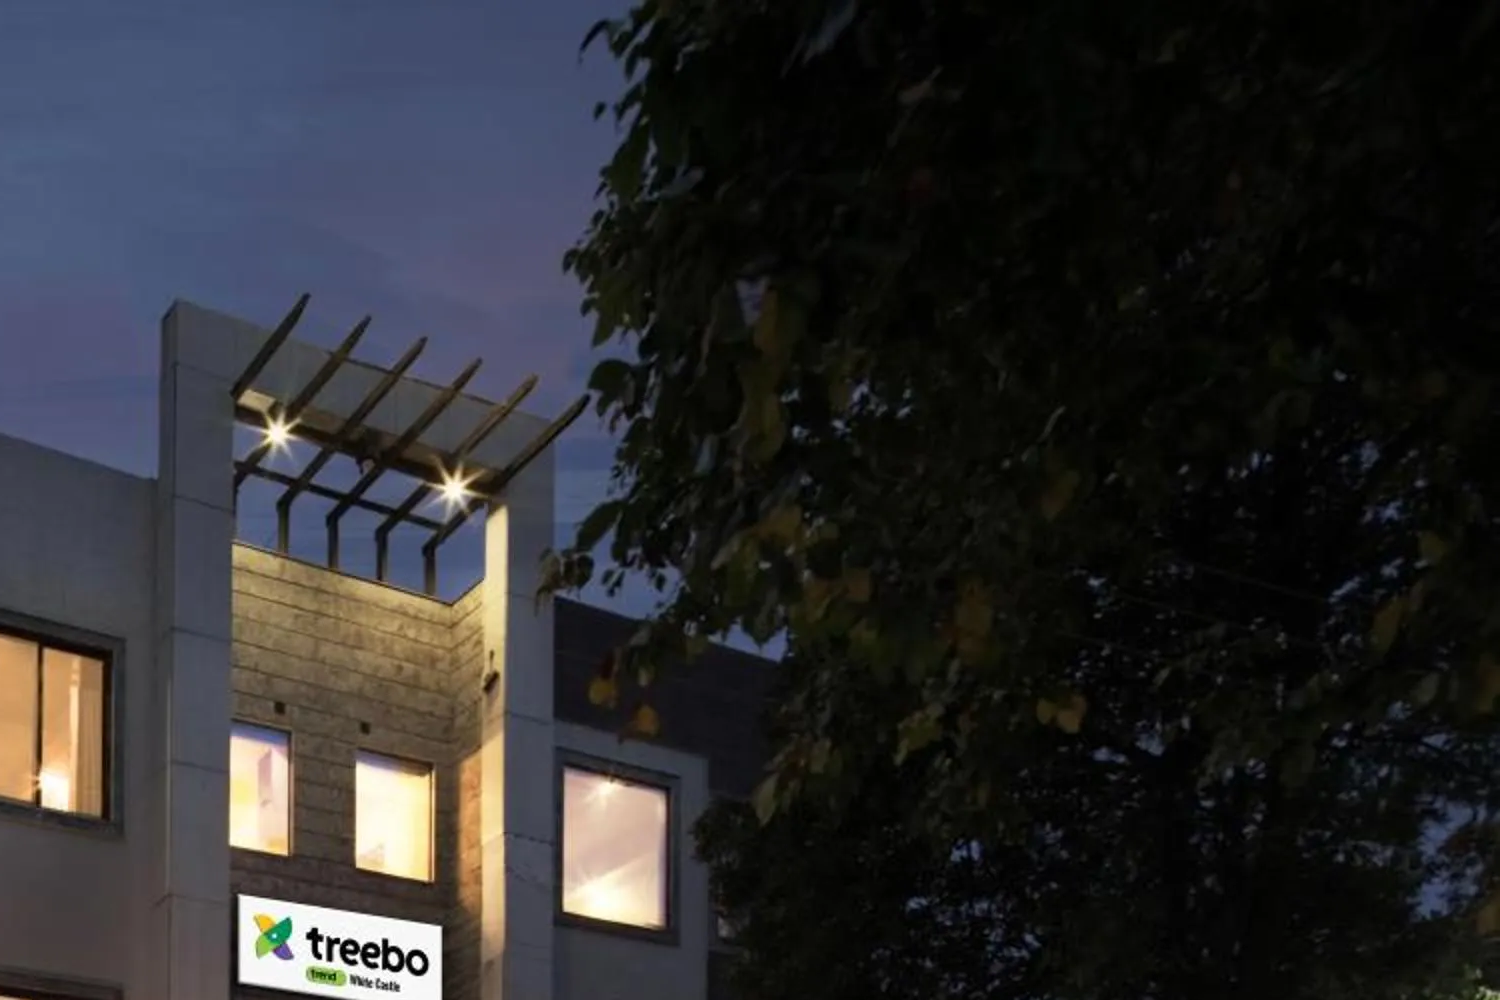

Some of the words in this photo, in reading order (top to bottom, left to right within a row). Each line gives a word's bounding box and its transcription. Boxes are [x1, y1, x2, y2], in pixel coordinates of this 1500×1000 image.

[306, 927, 429, 976] treebo
[310, 968, 337, 981] trend
[350, 974, 373, 989] White
[375, 978, 401, 992] Castle
